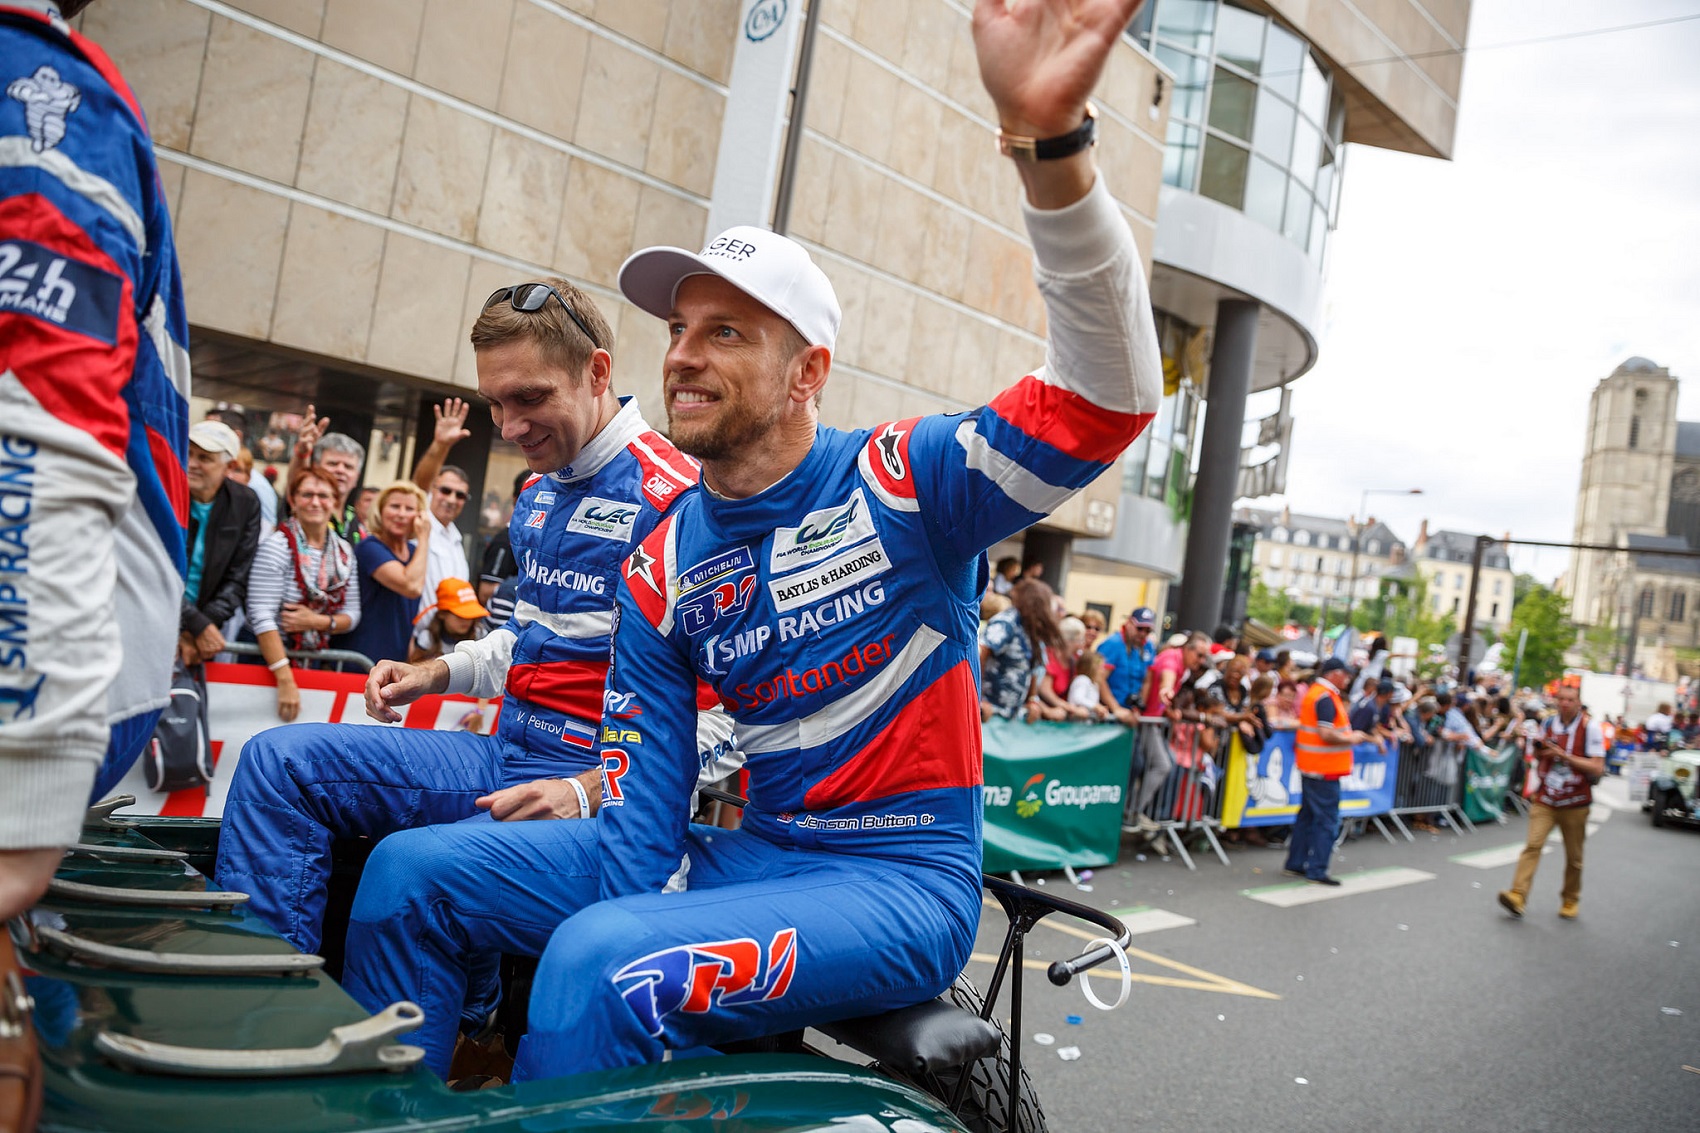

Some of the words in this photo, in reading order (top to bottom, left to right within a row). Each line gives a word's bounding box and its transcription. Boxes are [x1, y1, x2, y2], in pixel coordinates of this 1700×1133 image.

[646, 476, 675, 497] OMP
[786, 545, 808, 556] WORLD
[536, 565, 606, 595] RACING
[693, 555, 742, 583] MICHELIN
[776, 578, 820, 602] BAYLIS
[821, 574, 831, 587] &
[828, 550, 882, 581] HARDING
[718, 625, 771, 663] SMP
[778, 581, 886, 643] RACING
[735, 633, 895, 709] Santander
[516, 710, 525, 724] V.
[527, 715, 563, 735] Petrov
[1045, 779, 1122, 811] Groupama
[796, 814, 859, 831] Jenson
[861, 813, 917, 829] Button
